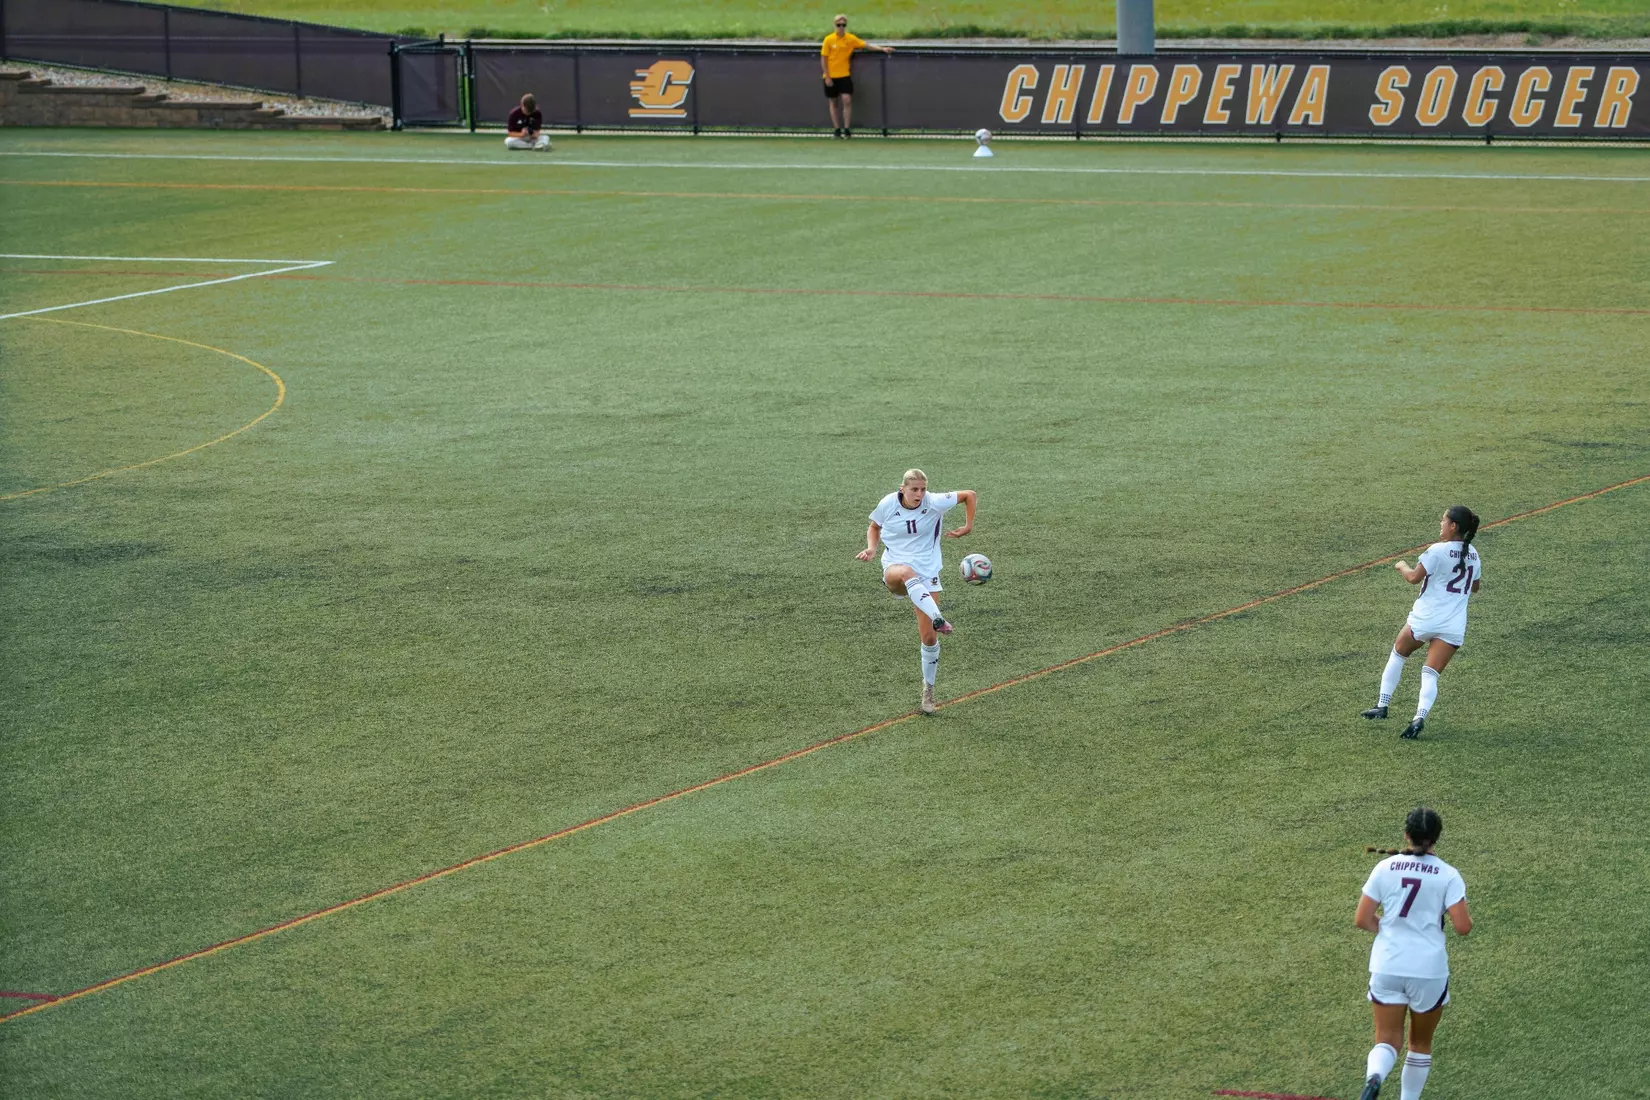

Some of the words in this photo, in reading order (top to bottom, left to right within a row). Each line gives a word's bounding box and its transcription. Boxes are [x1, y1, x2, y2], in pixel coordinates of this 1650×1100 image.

[999, 64, 1331, 124] CHIPPEWA
[1369, 65, 1640, 127] SOCCER
[906, 519, 918, 534] 11
[1446, 563, 1474, 595] 21
[1390, 861, 1440, 874] CHIPPEWAS
[1399, 877, 1422, 918] 7
